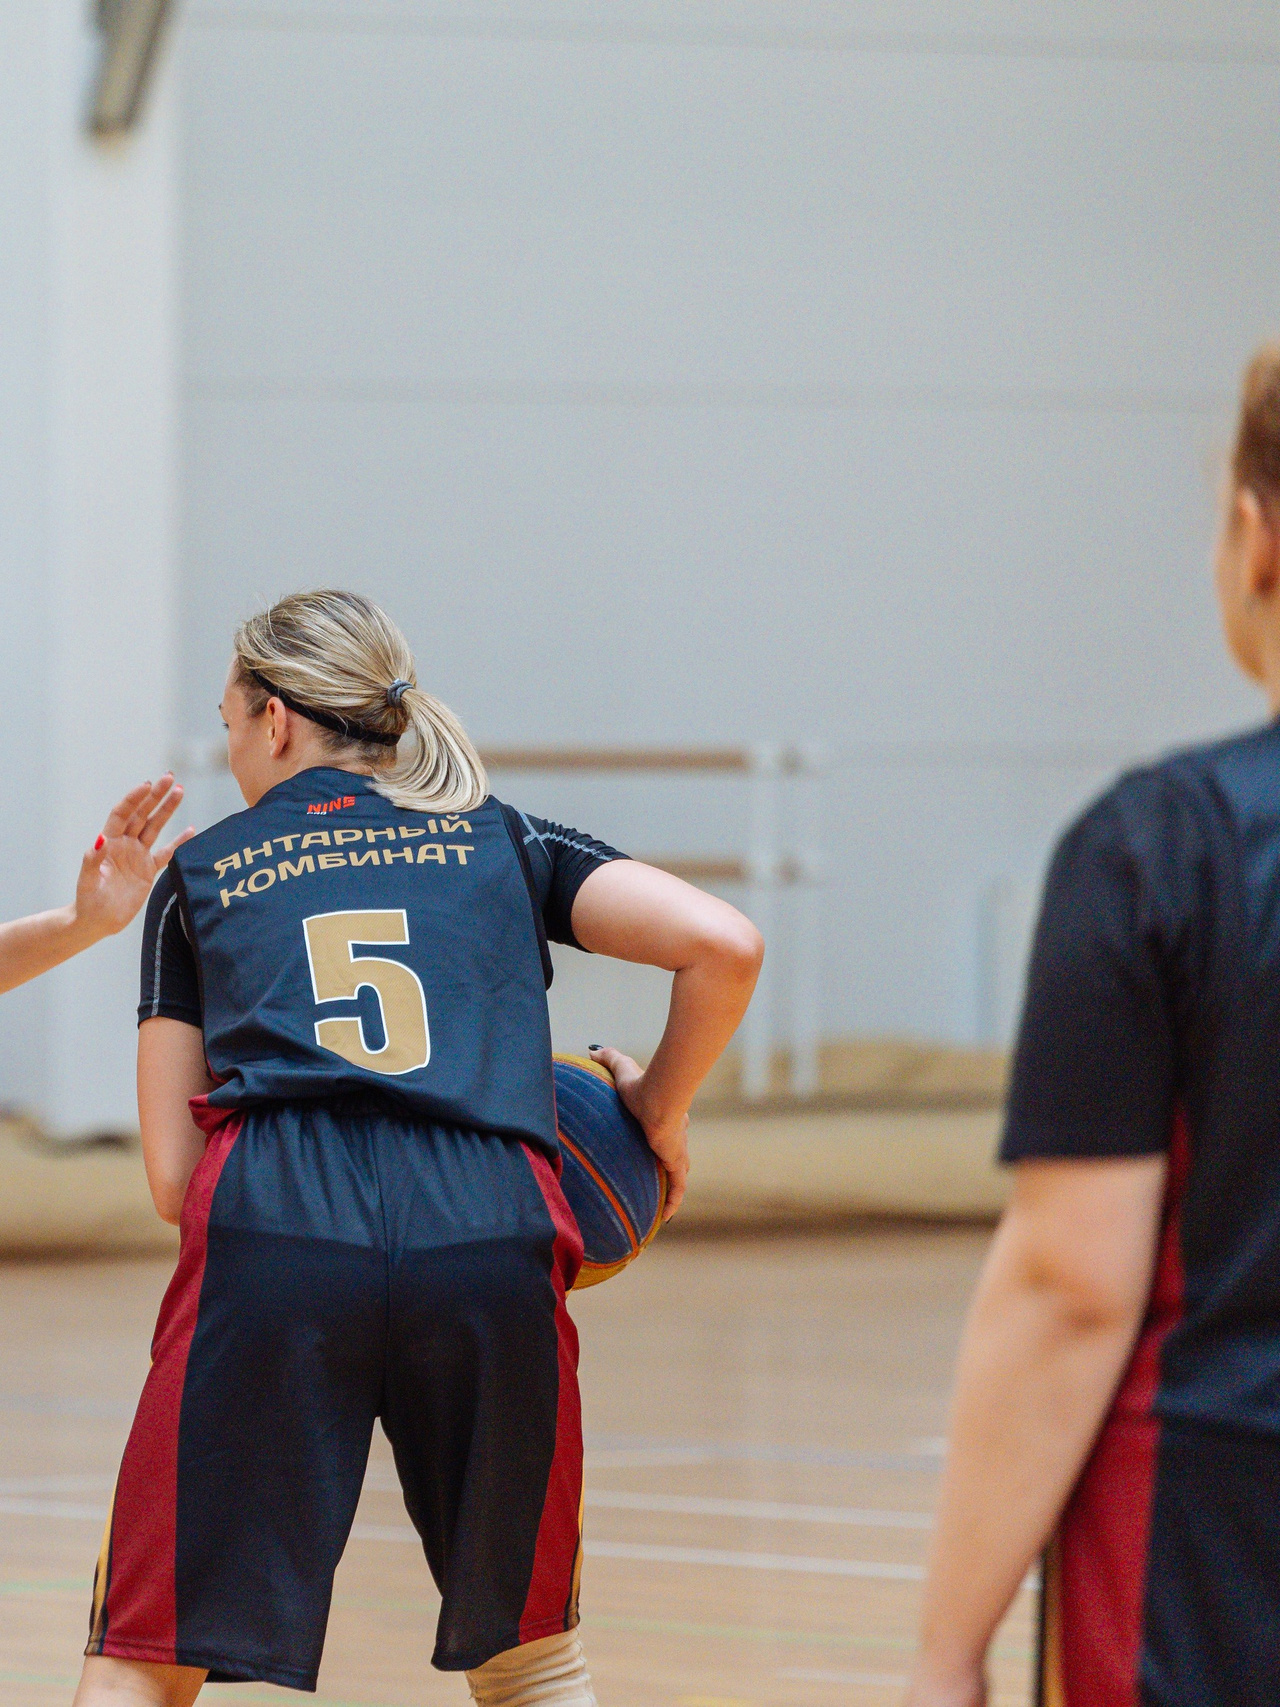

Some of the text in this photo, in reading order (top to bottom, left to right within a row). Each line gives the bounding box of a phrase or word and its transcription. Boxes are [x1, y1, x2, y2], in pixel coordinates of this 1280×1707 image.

[213, 815, 473, 880] ЯНТАРНЫЙ
[219, 843, 475, 908] КОМБИНАТ
[302, 908, 431, 1076] 5
